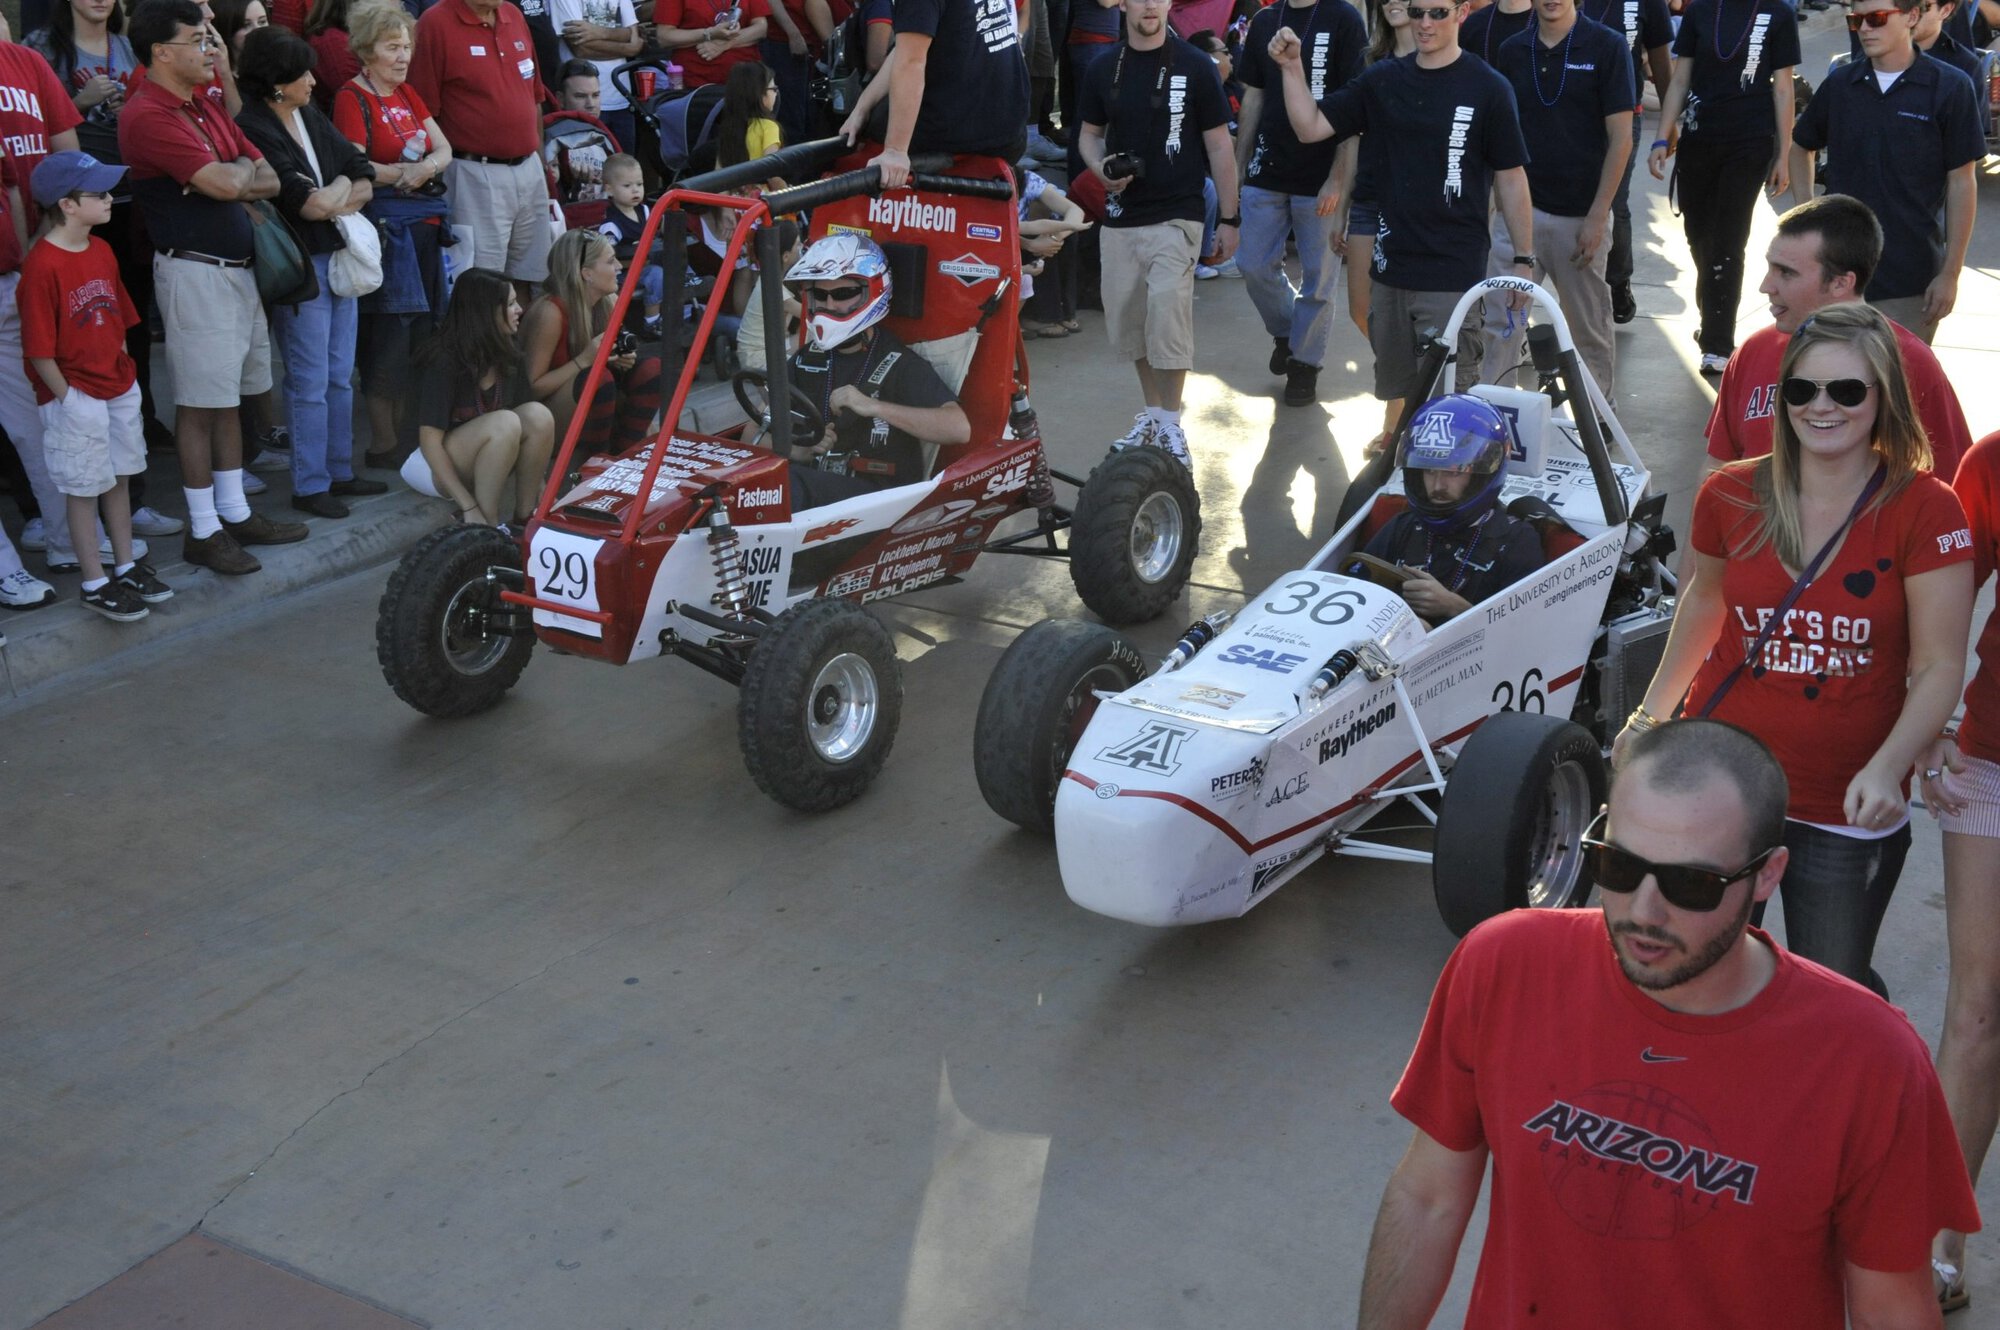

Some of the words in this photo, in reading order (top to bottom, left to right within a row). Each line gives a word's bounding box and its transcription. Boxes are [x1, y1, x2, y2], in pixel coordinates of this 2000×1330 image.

[1623, 1, 1639, 12] UA
[1755, 13, 1772, 26] UA
[1314, 32, 1330, 46] UA
[1749, 24, 1769, 44] Baja
[1310, 45, 1328, 68] Baja
[1742, 41, 1765, 85] Racing
[1156, 66, 1167, 90] Canon
[1170, 75, 1187, 89] UA
[1168, 90, 1187, 113] Baja
[1453, 105, 1475, 122] UA
[1165, 113, 1186, 156] Racing
[1448, 122, 1471, 147] Baja
[1443, 148, 1466, 198] Racing
[868, 194, 957, 233] Raytheon
[1480, 279, 1534, 292] ARIZONA
[737, 484, 783, 509] Fastenal
[982, 461, 1032, 500] SAE
[877, 538, 926, 565] Lockheed
[923, 531, 957, 551] Martin
[539, 547, 588, 600] 29
[880, 566, 893, 584] AZ
[892, 553, 942, 580] Engineering
[1486, 606, 1506, 625] THE
[1509, 571, 1562, 612] UNIVERSITY
[1563, 563, 1577, 580] OF
[1578, 538, 1625, 573] ARIZONA
[861, 568, 947, 605] POLARIS
[1264, 580, 1367, 626] 36
[1252, 632, 1285, 644] painting
[1832, 615, 1871, 644] GO
[1217, 644, 1308, 674] SAE
[1409, 695, 1423, 709] HE
[1425, 675, 1456, 703] METAL
[1458, 660, 1484, 684] MAN
[1491, 667, 1545, 712] 36
[1299, 709, 1355, 752] LOCKHEED
[1359, 683, 1396, 713] MARTIN
[1319, 701, 1396, 765] Raytheon
[1521, 1100, 1758, 1204] ARIZONA
[1539, 1136, 1721, 1211] BASKETBALL
